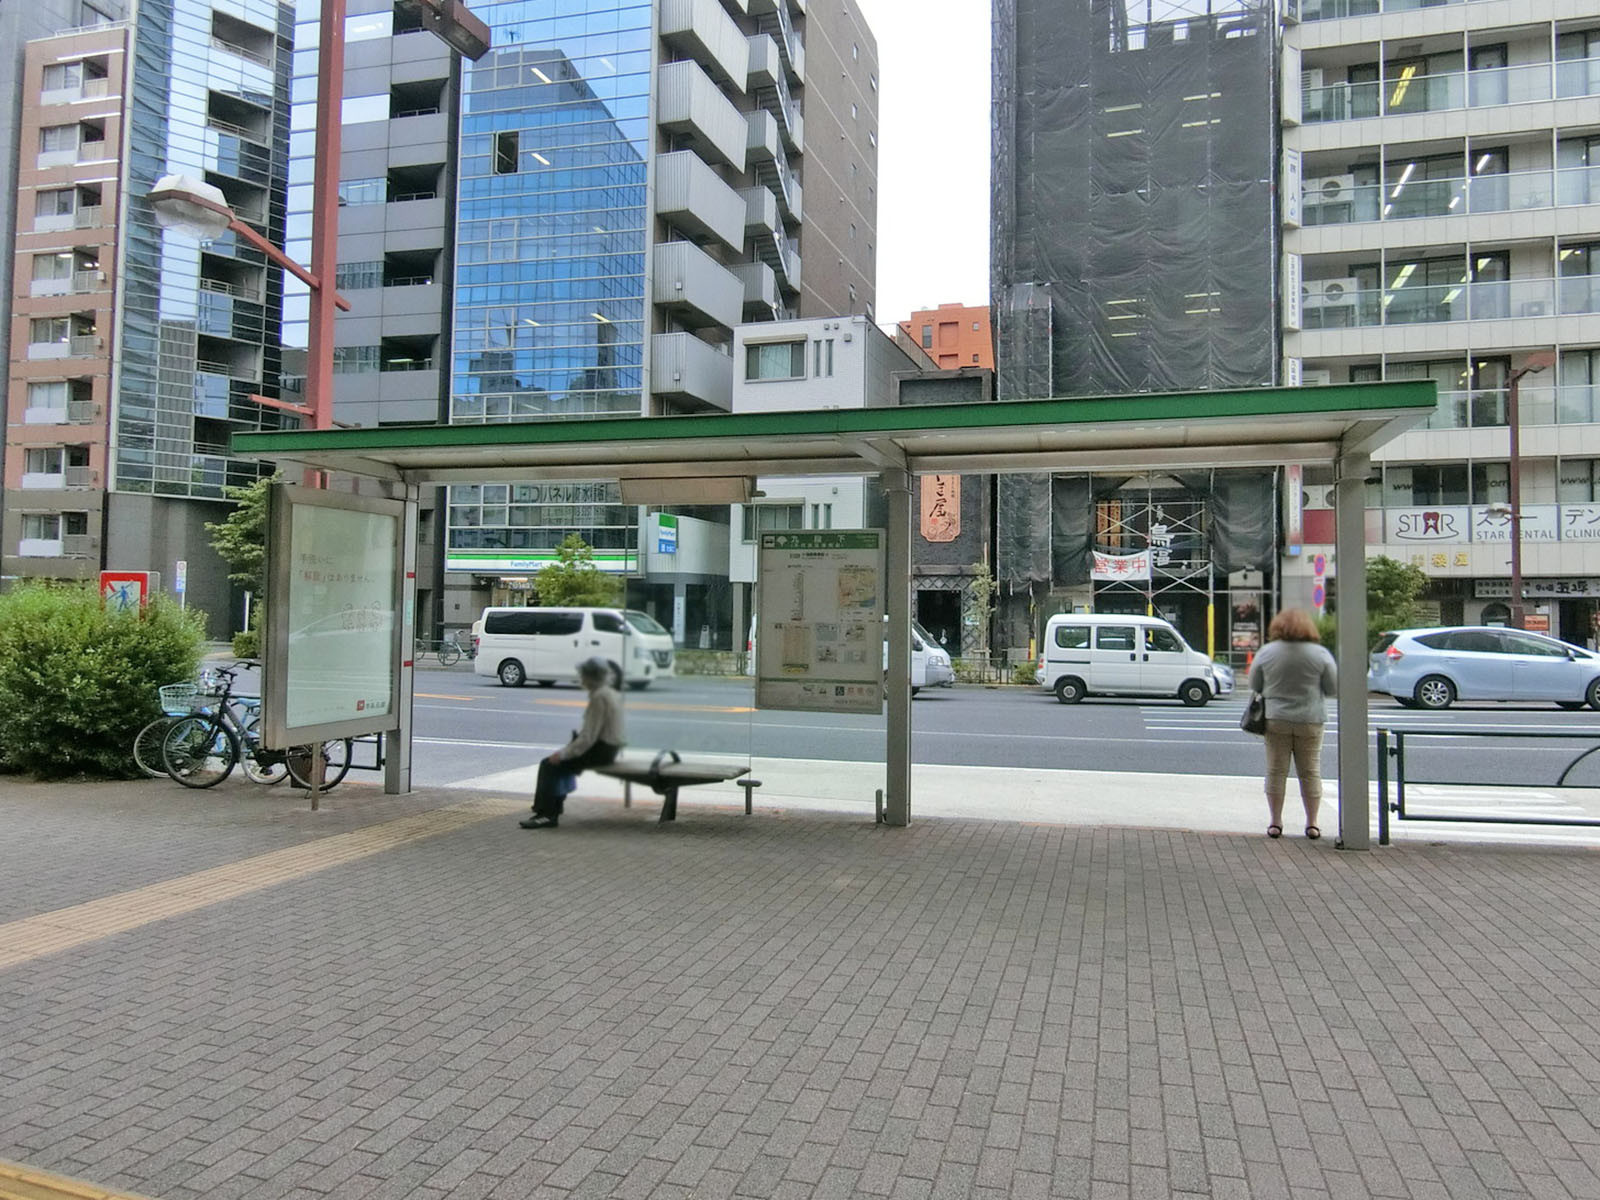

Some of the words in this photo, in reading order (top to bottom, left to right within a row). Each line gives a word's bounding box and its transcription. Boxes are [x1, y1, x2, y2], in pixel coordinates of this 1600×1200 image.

[1398, 512, 1455, 535] STAR
[1476, 530, 1505, 540] STAR
[510, 560, 543, 568] FamilyMart
[1093, 557, 1147, 574] 営業中
